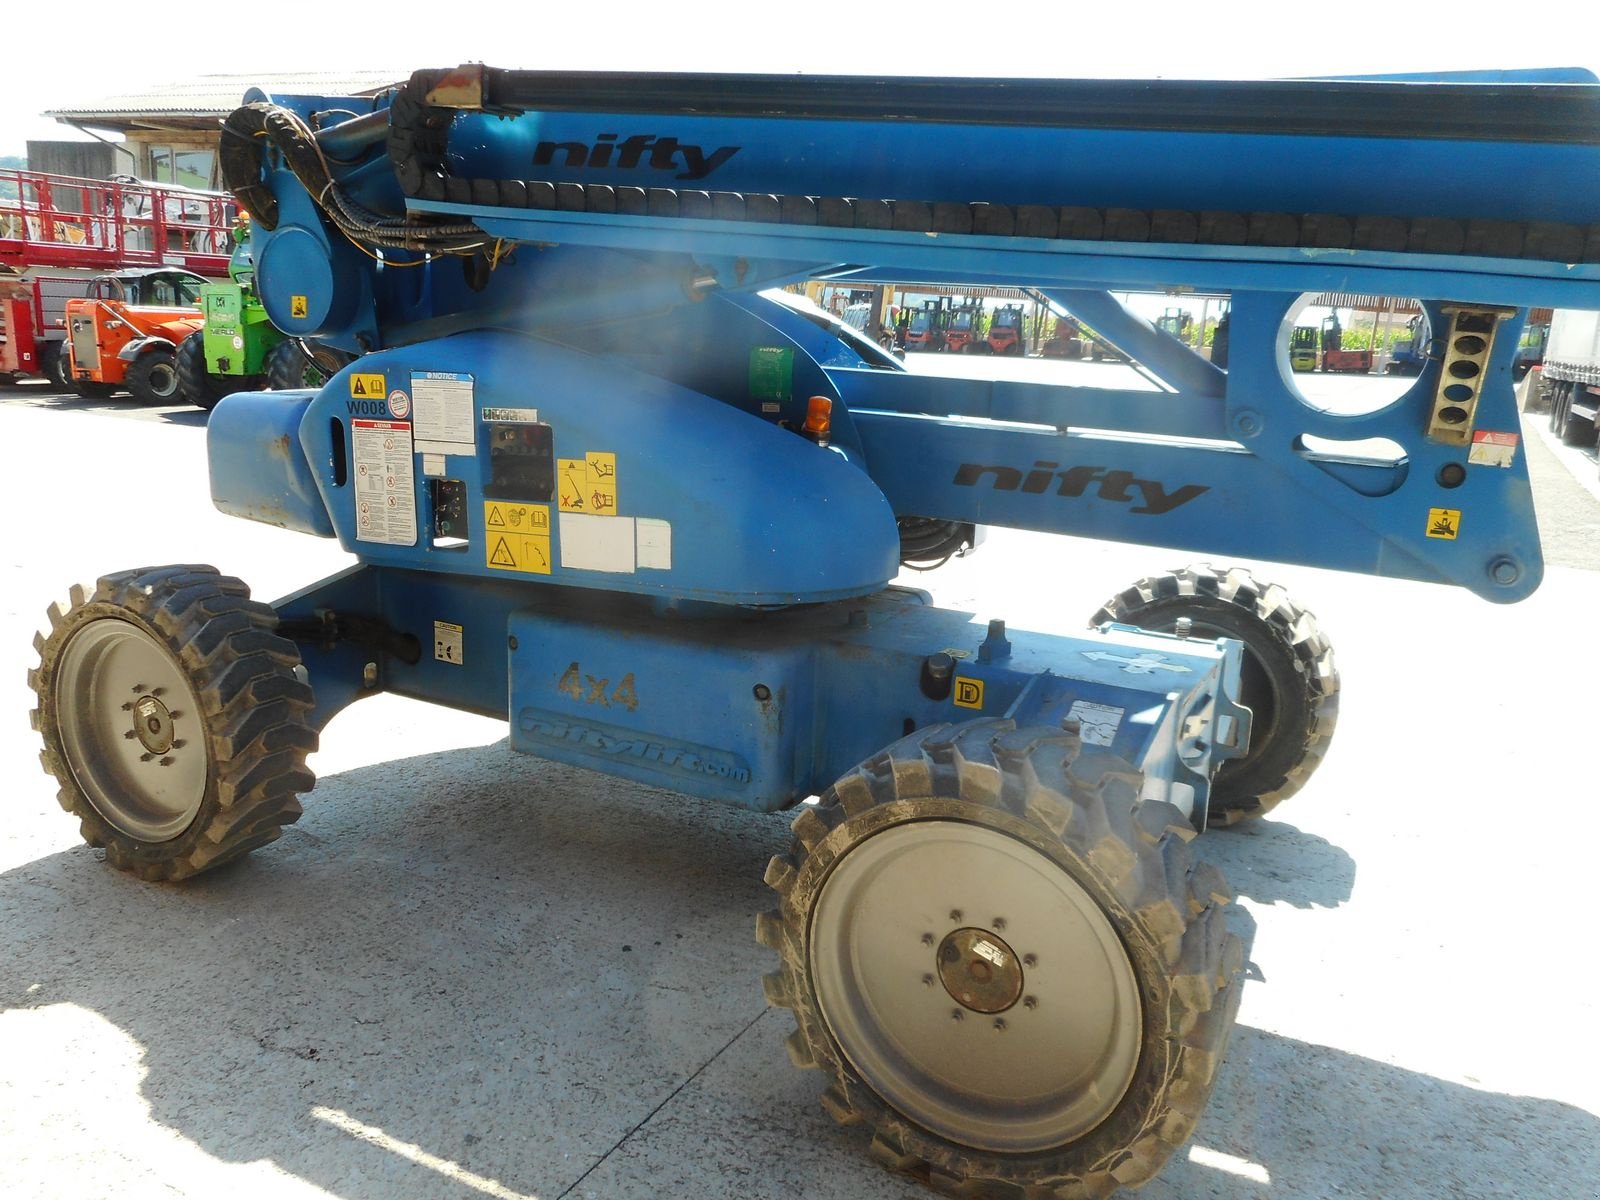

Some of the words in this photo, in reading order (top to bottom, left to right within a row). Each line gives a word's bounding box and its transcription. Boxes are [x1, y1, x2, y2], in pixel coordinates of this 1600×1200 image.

[532, 133, 742, 181] nifty
[432, 372, 458, 381] NOTICE
[346, 401, 386, 415] W008
[952, 461, 1210, 515] nifty
[557, 661, 639, 713] 4x4
